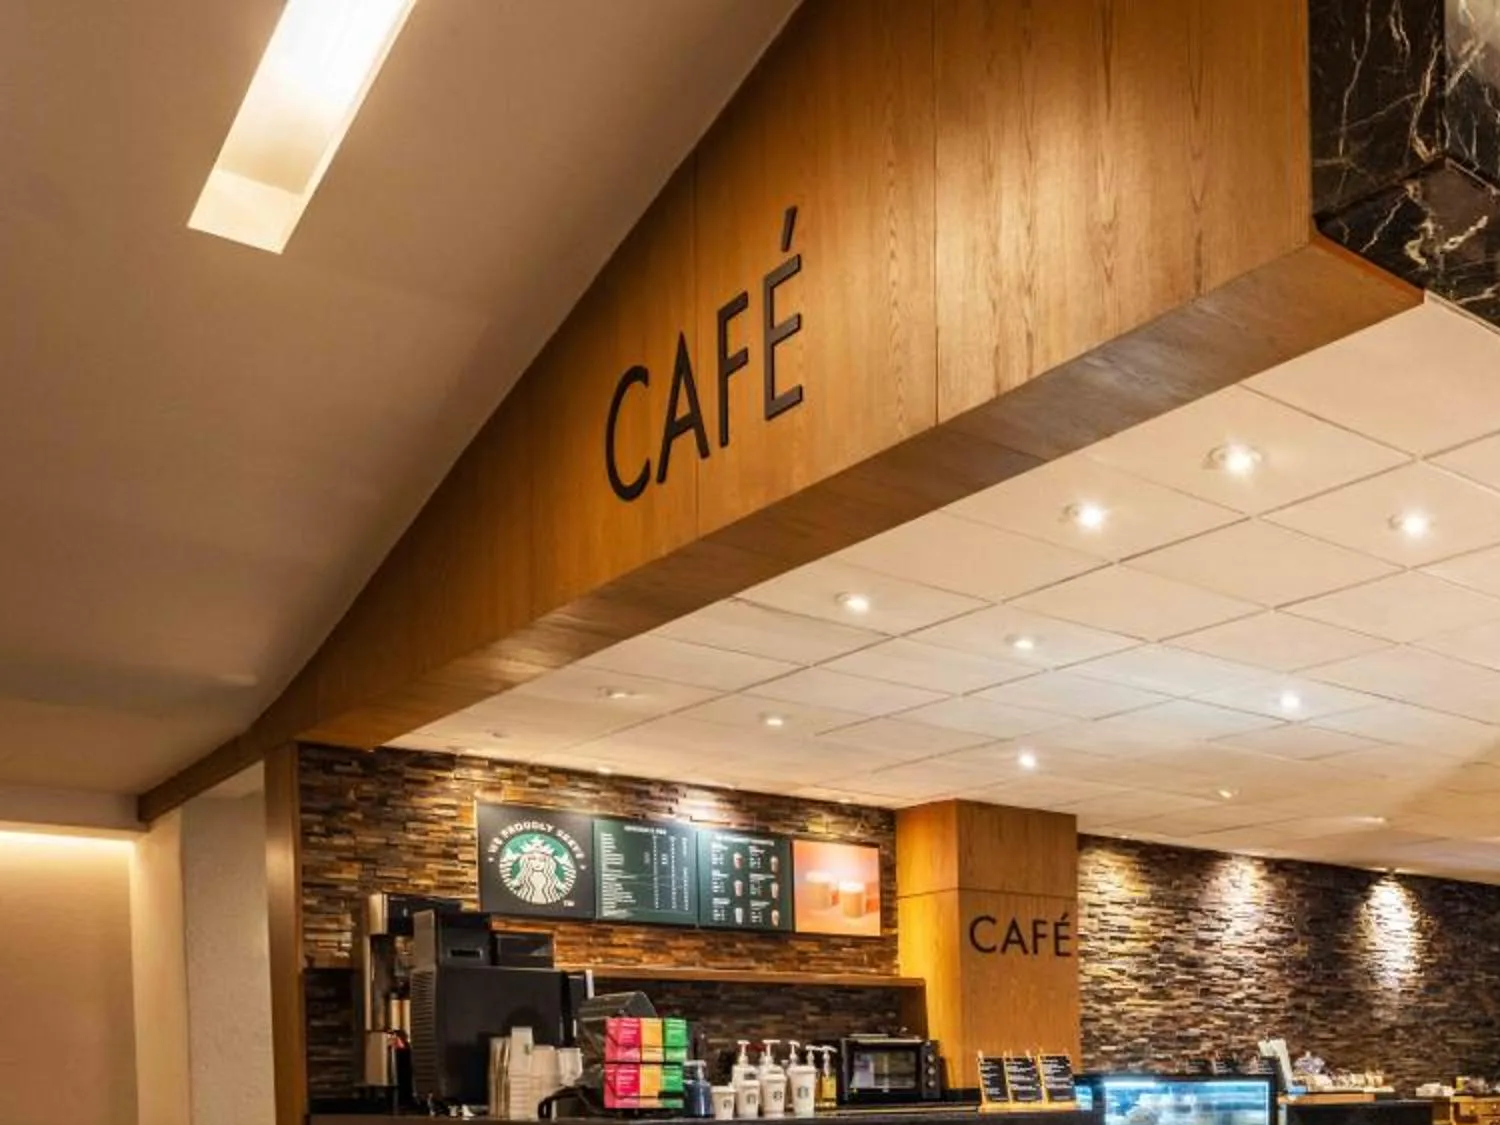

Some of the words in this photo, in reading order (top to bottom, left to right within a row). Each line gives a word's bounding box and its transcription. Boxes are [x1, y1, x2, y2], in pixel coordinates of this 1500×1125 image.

[606, 206, 803, 502] CAFÉ
[501, 821, 554, 838] PROUDLY
[969, 912, 1072, 957] CAFÉ
